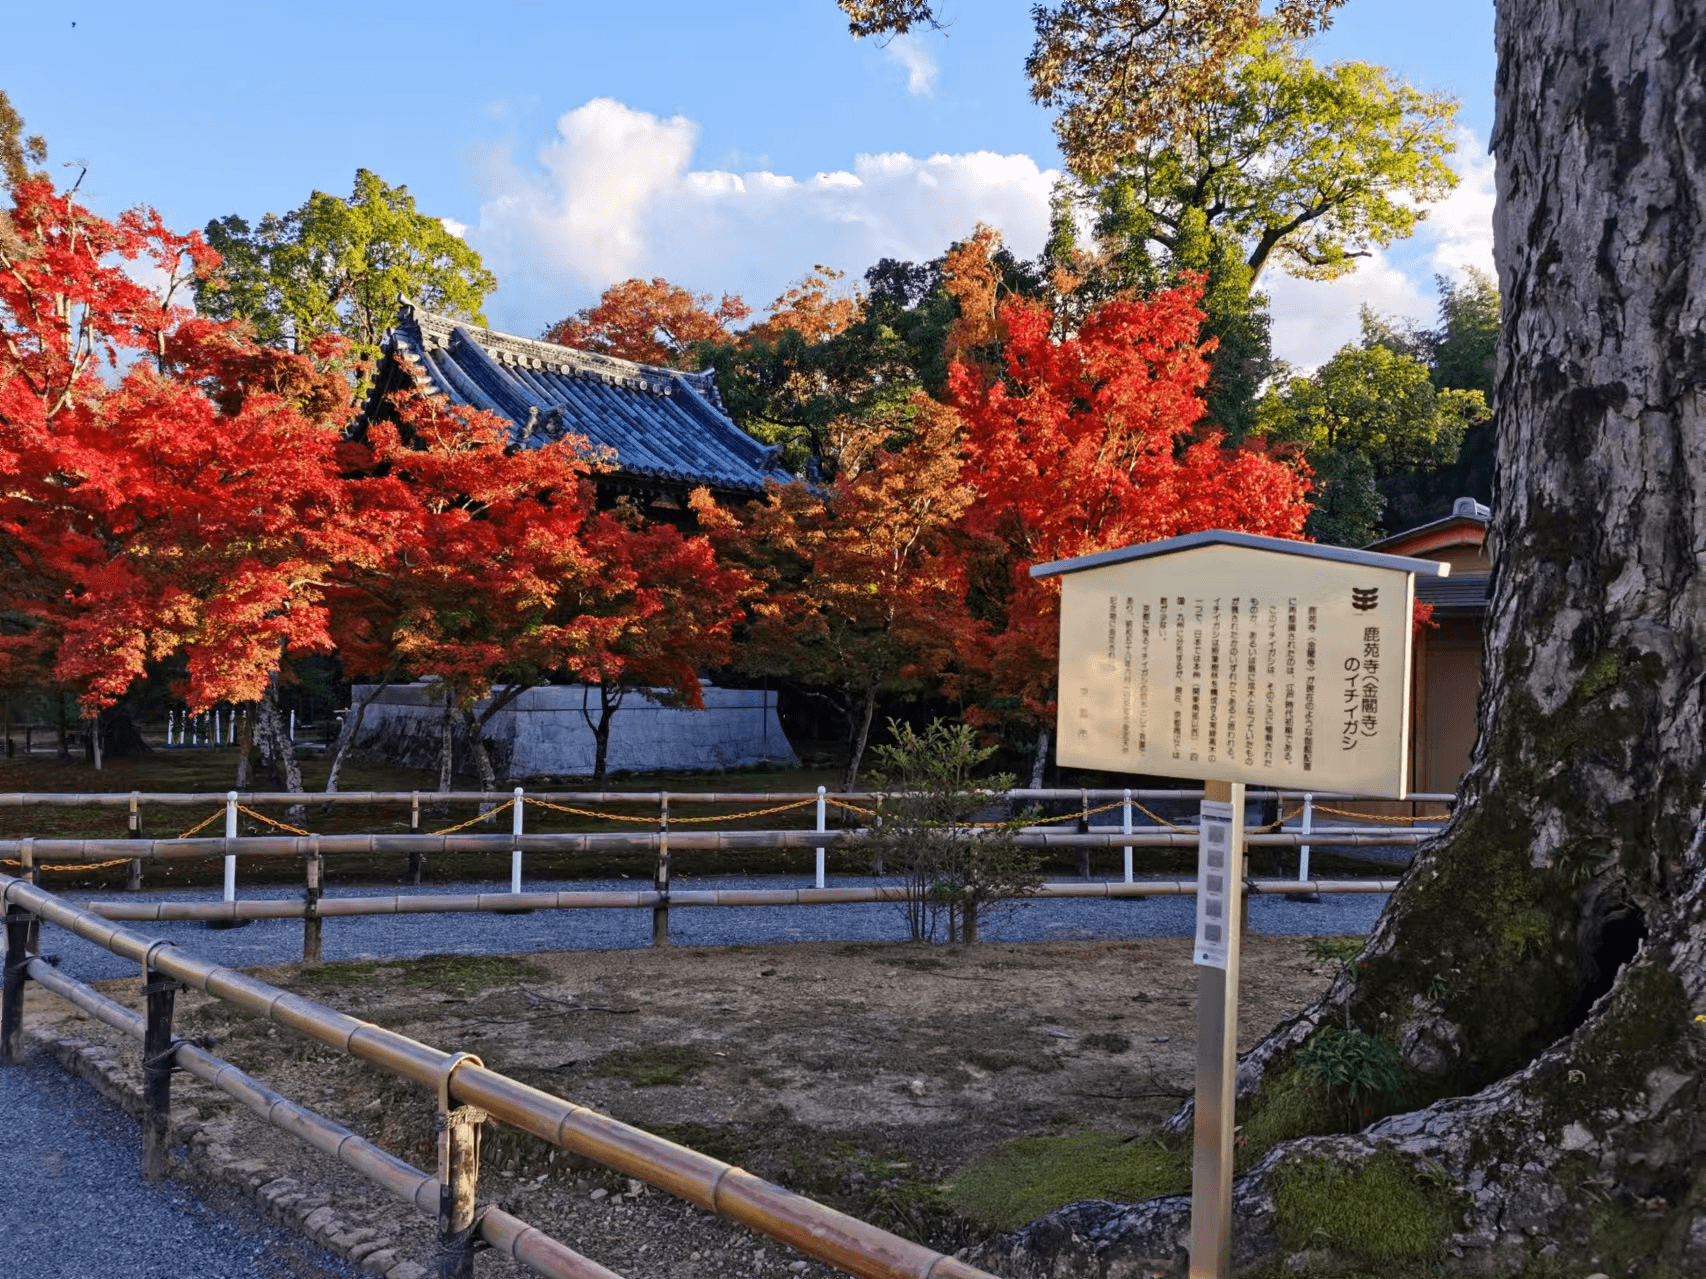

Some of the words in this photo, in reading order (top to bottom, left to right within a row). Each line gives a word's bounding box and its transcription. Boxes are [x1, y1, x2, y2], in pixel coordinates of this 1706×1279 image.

[1342, 657, 1360, 751] のイチイガシ
